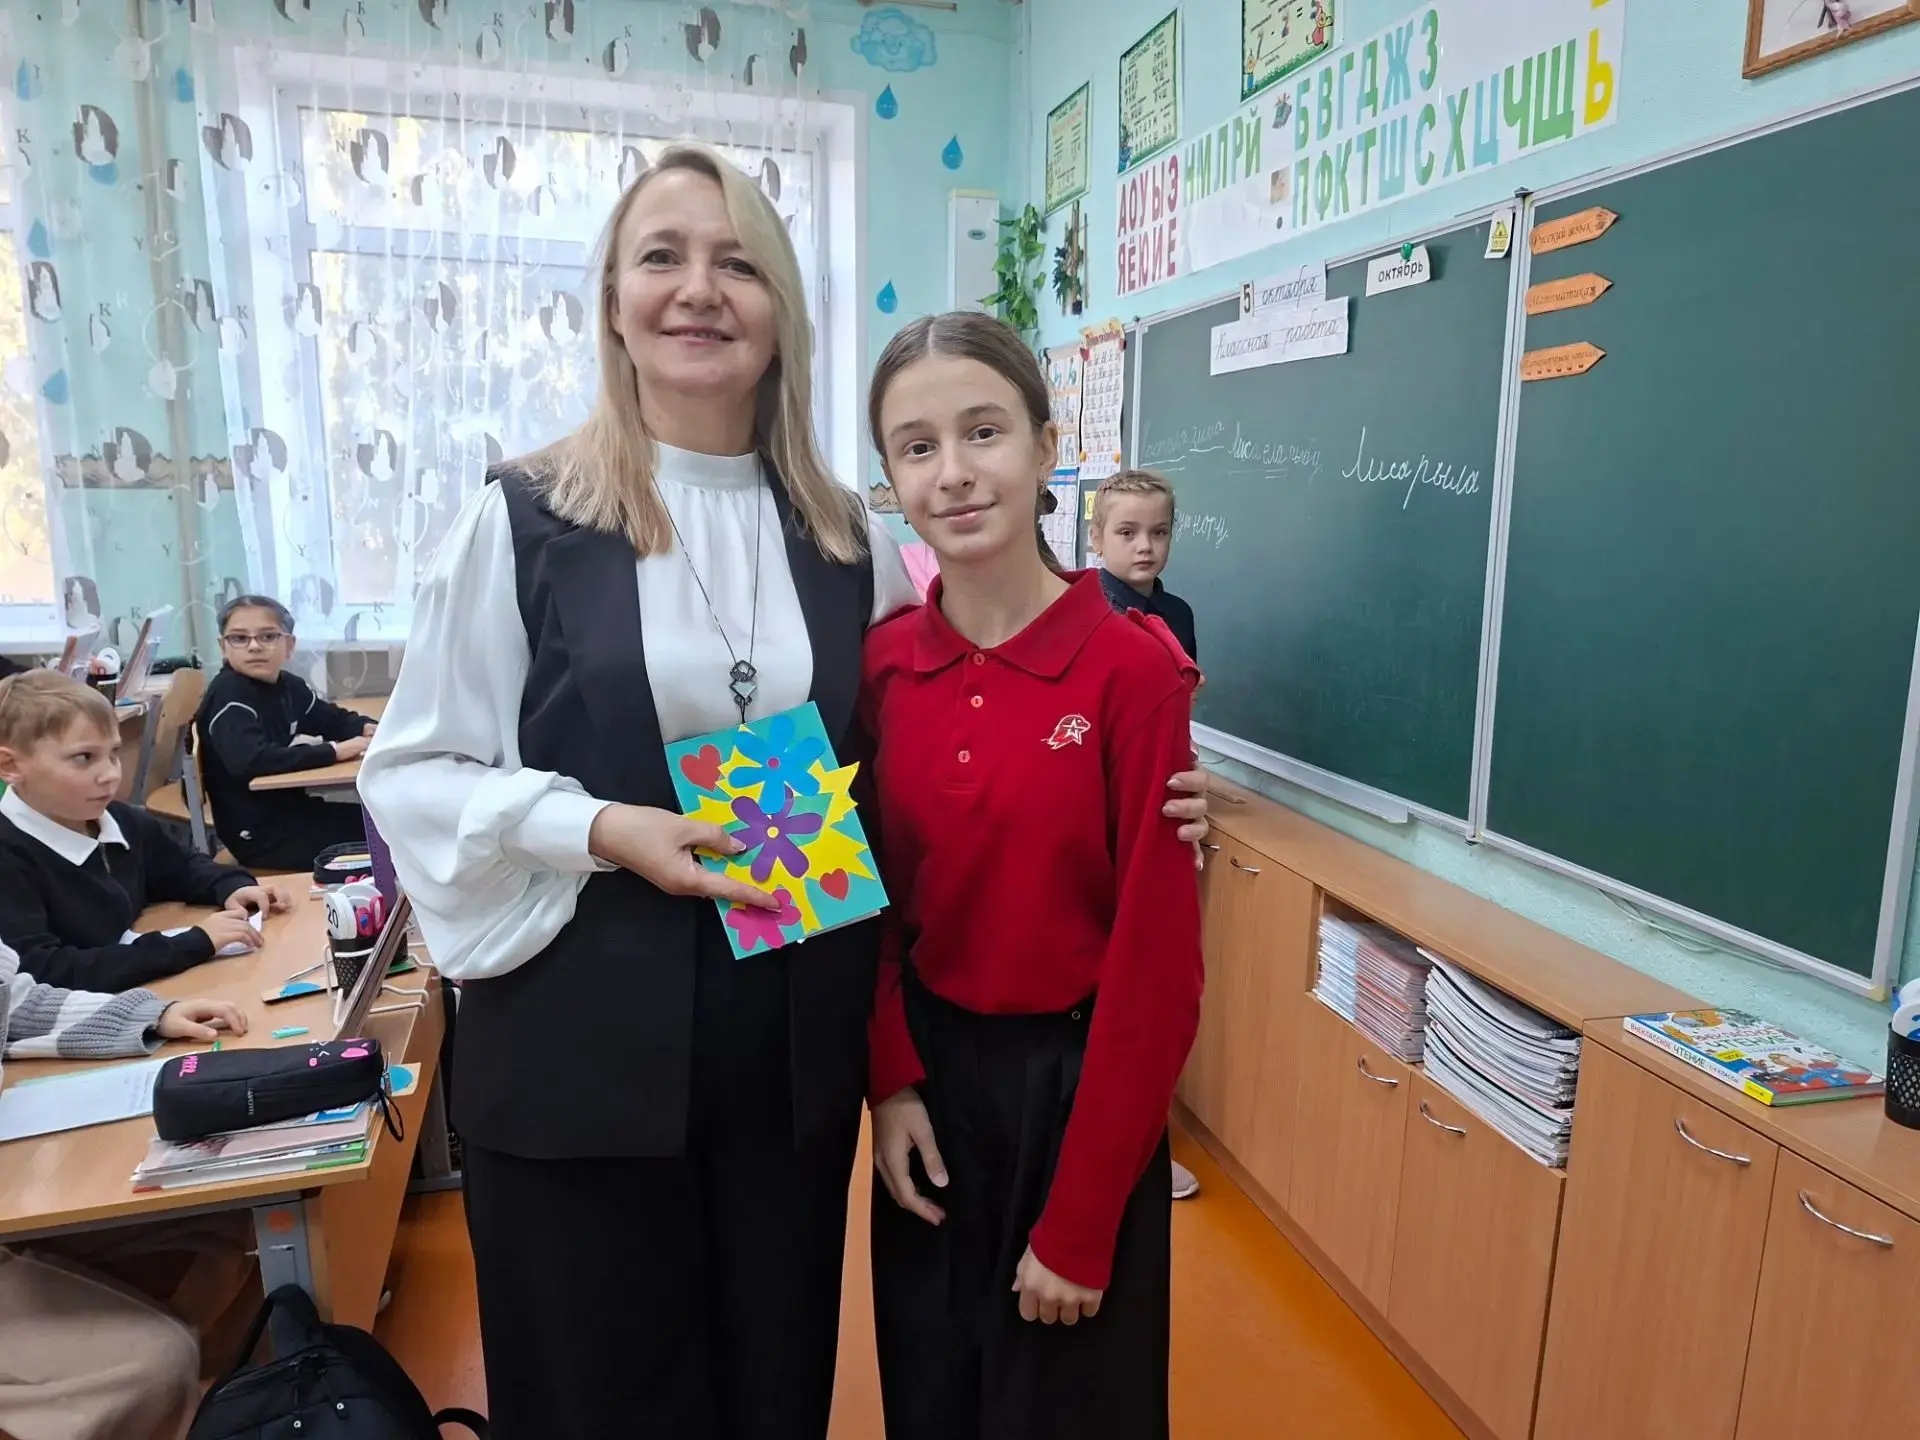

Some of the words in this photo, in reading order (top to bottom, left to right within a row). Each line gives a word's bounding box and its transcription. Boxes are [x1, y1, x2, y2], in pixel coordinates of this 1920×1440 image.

[1243, 283, 1252, 314] 5
[1261, 264, 1319, 309] октября
[1214, 332, 1271, 360] Классная
[1282, 308, 1341, 355] работа
[1341, 426, 1413, 482] Лиса
[1402, 454, 1480, 511] рыла
[326, 903, 339, 929] 20
[1630, 1023, 1671, 1049] ВНЕКЛАССНОЕ
[1673, 1043, 1706, 1068] ЧТЕНИЕ
